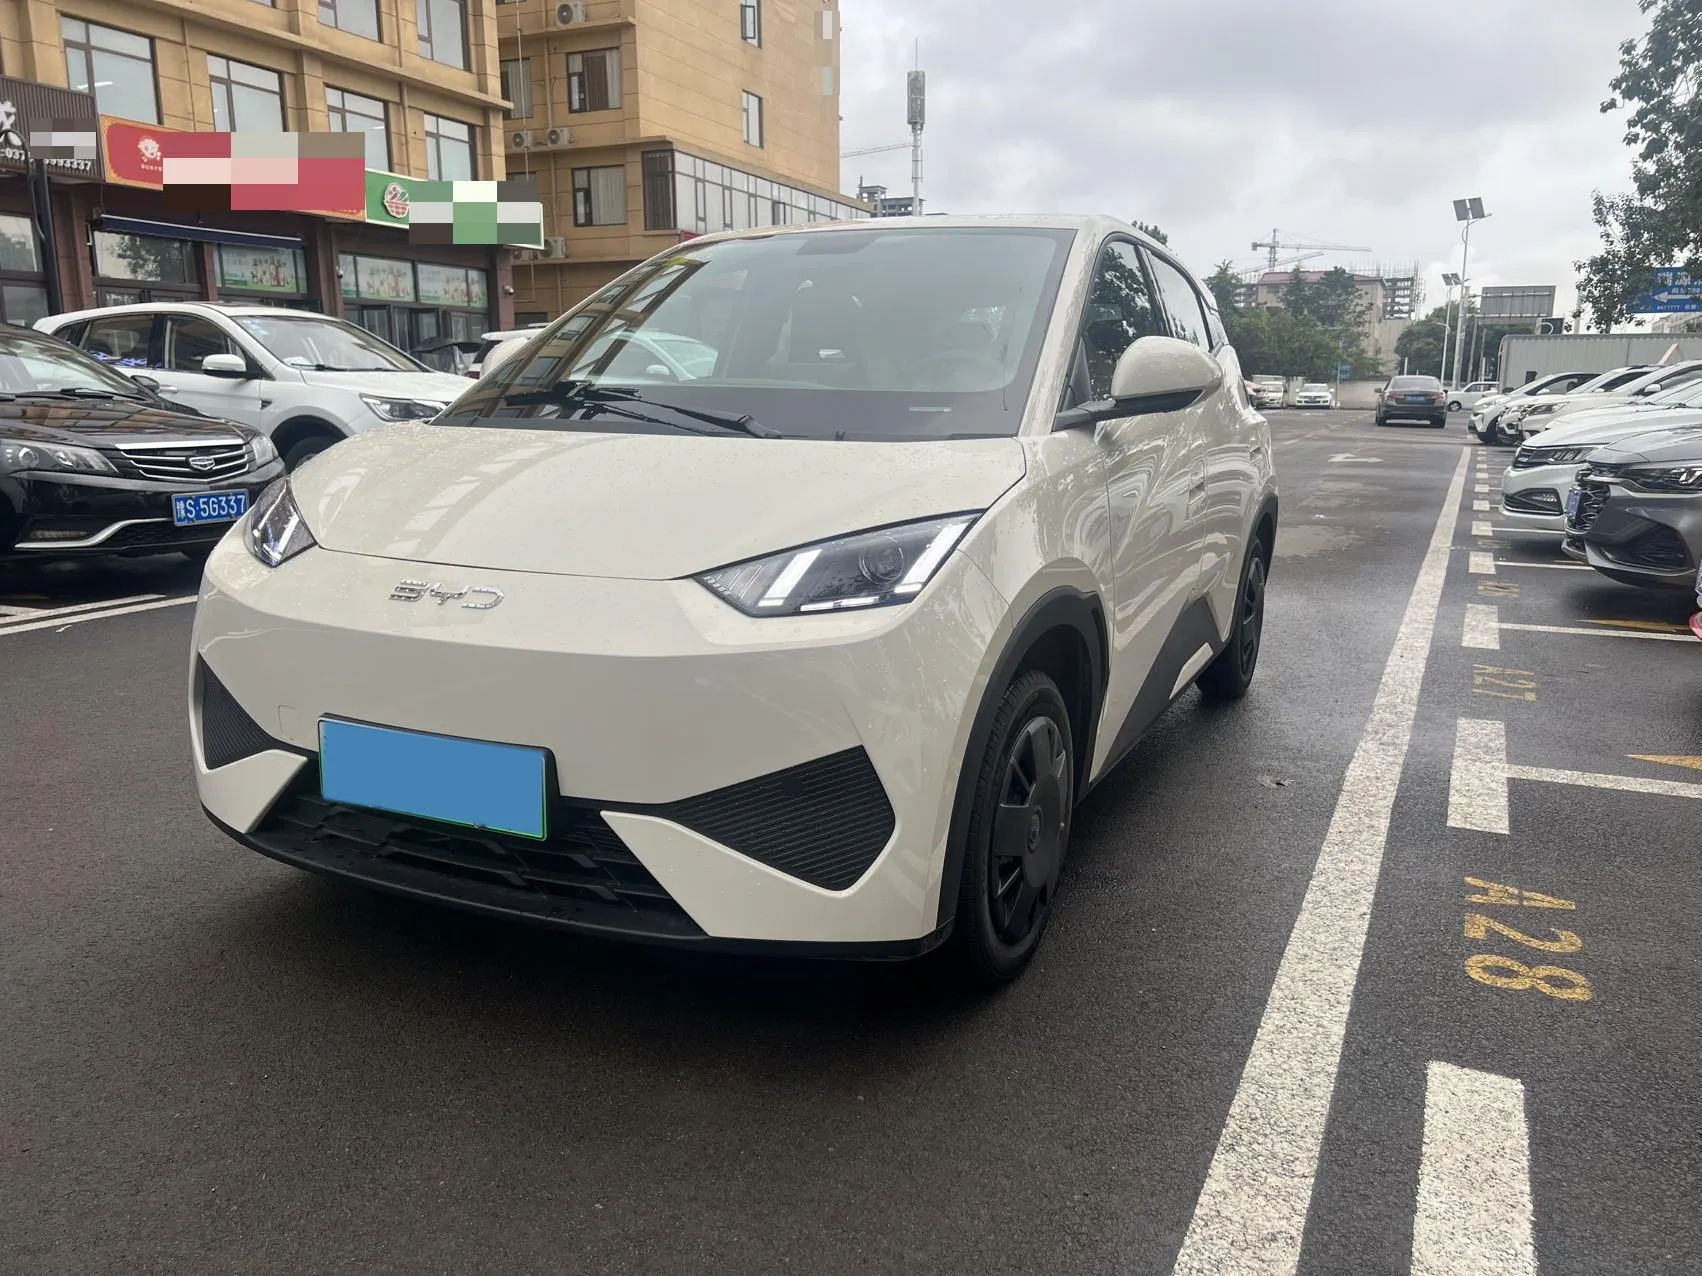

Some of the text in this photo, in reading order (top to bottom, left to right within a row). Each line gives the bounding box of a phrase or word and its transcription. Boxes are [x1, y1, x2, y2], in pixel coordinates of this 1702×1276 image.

[389, 578, 505, 610] BYD
[1472, 663, 1537, 702] A27
[1464, 876, 1593, 1002] A28
